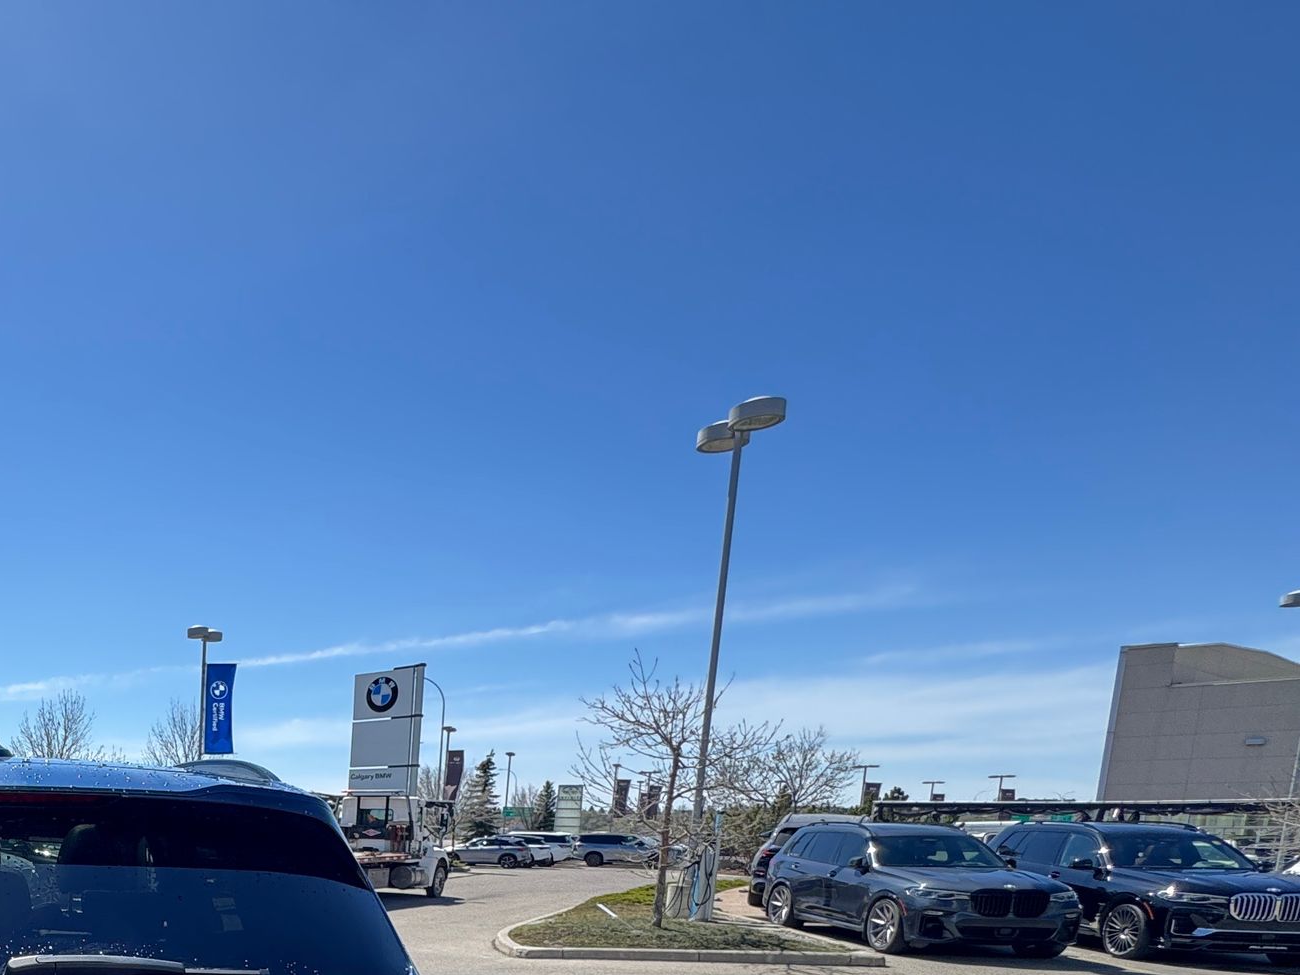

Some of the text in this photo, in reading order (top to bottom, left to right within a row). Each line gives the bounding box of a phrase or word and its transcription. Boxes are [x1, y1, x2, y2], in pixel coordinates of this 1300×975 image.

[211, 702, 219, 732] Certified
[218, 702, 226, 721] BMW
[350, 773, 374, 781] Calgary
